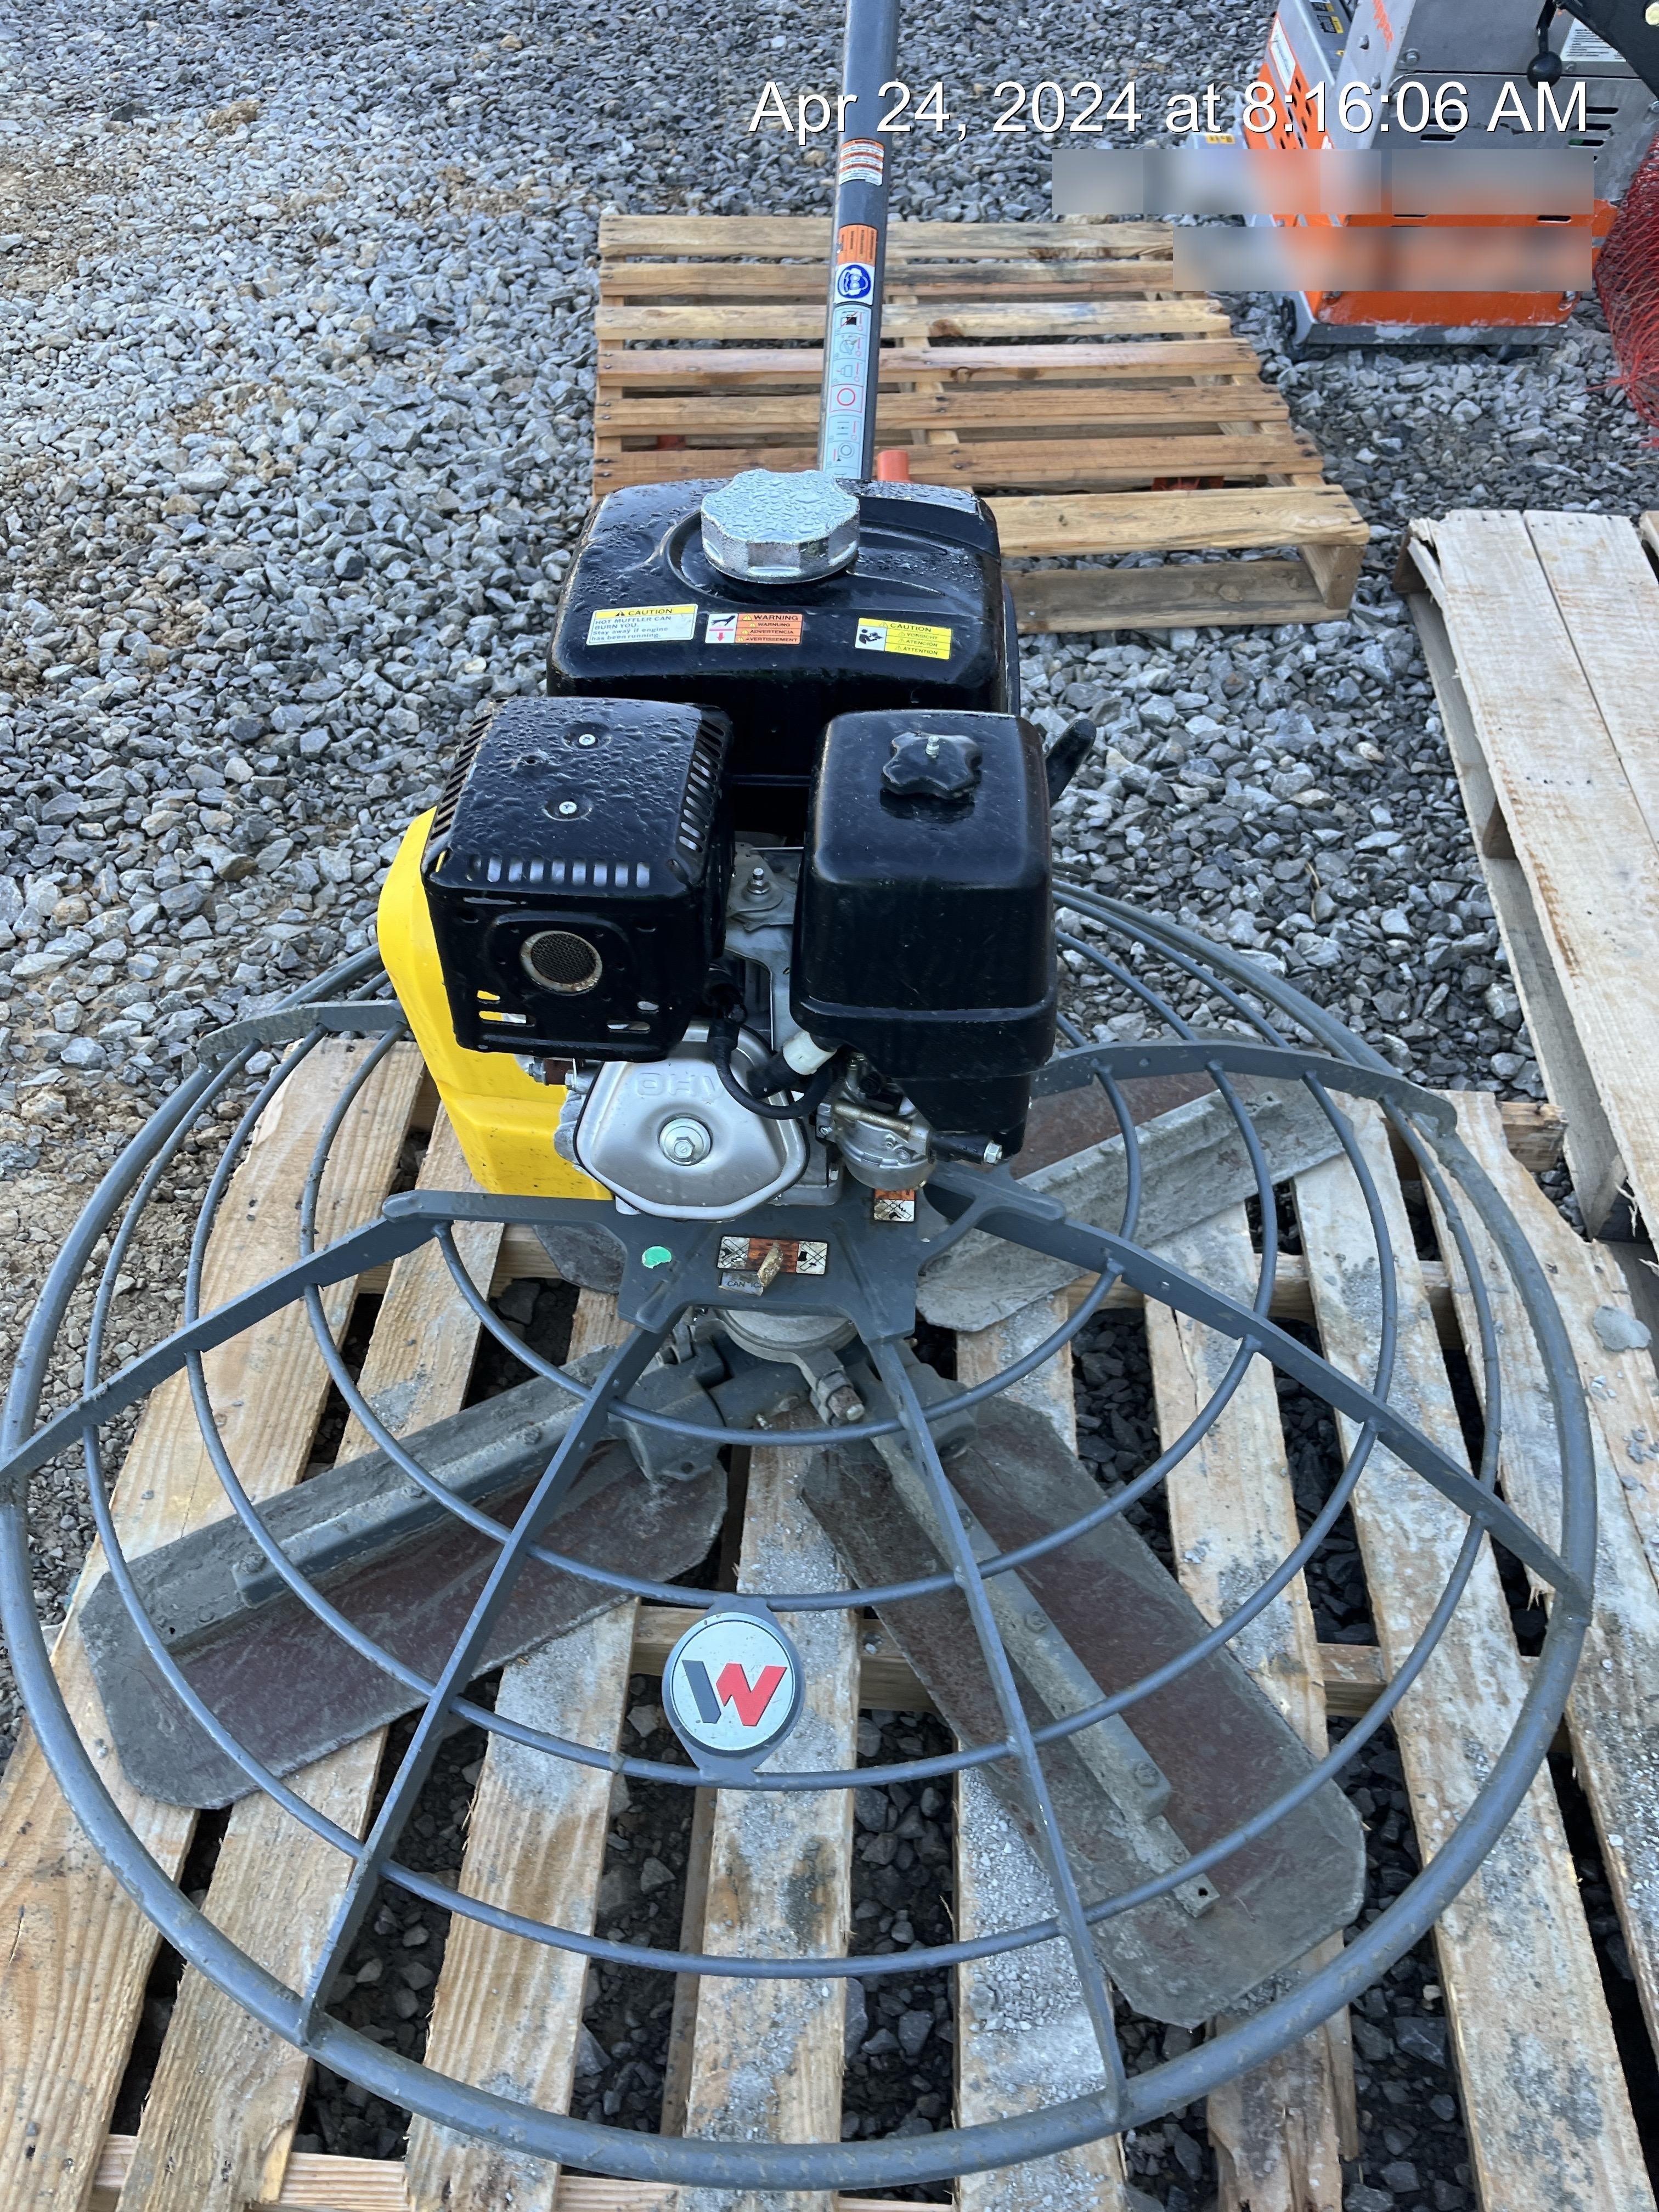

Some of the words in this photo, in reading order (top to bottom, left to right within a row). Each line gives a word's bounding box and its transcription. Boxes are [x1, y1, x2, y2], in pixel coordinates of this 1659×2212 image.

[890, 623, 932, 633] CAUTION
[902, 647, 938, 655] ATTENTION
[681, 1659, 788, 1727] W
